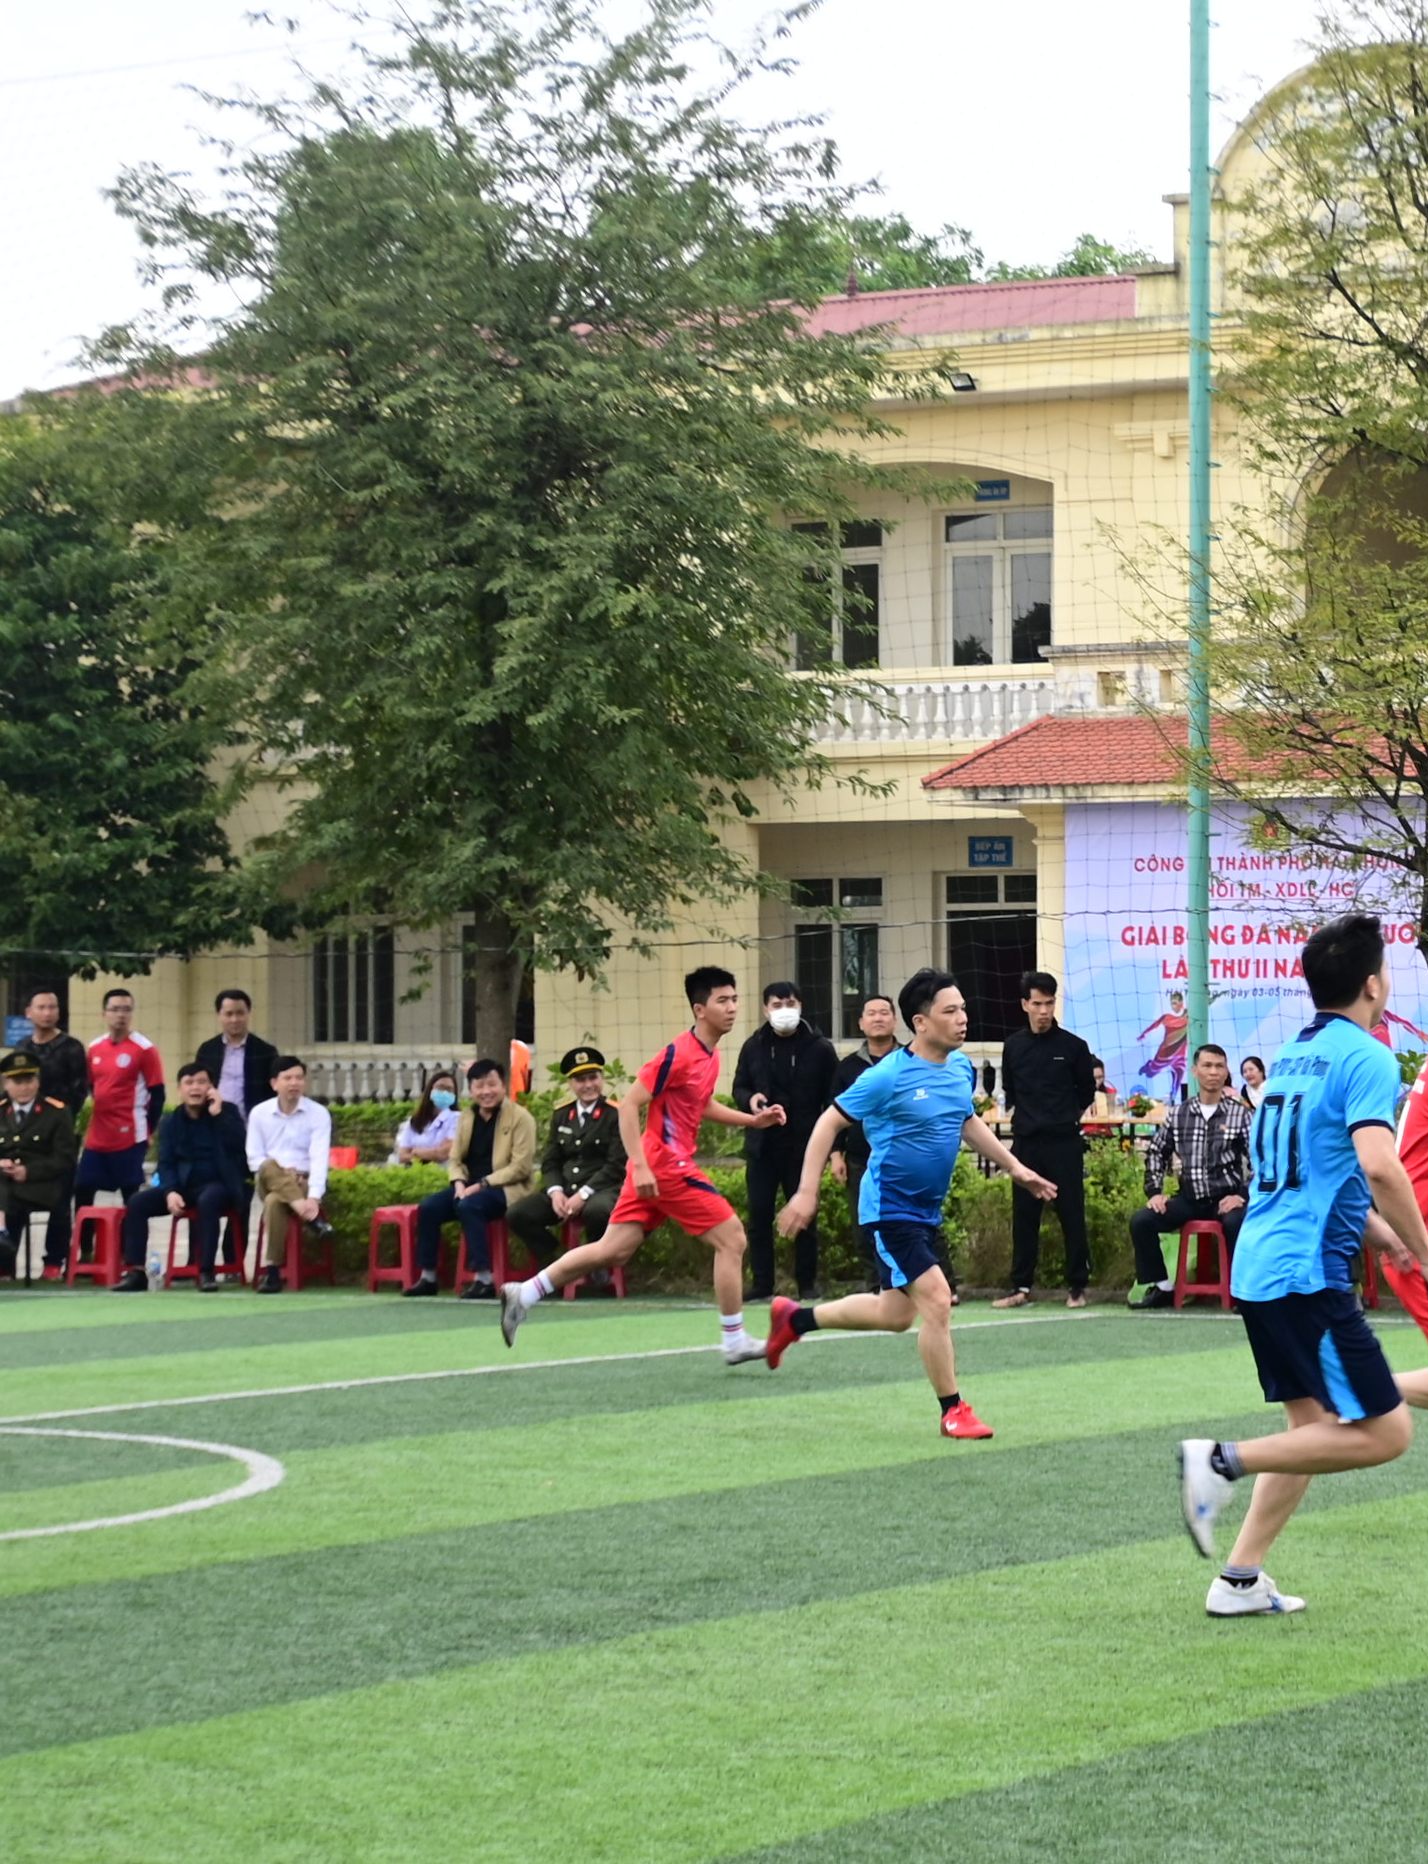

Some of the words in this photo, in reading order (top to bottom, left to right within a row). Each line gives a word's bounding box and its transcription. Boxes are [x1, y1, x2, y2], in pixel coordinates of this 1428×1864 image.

[1134, 853, 1184, 872] CÔNG
[1217, 852, 1272, 870] THÀNH
[1173, 924, 1236, 946] BNG
[1277, 924, 1320, 945] NA
[1255, 1092, 1307, 1196] 01
